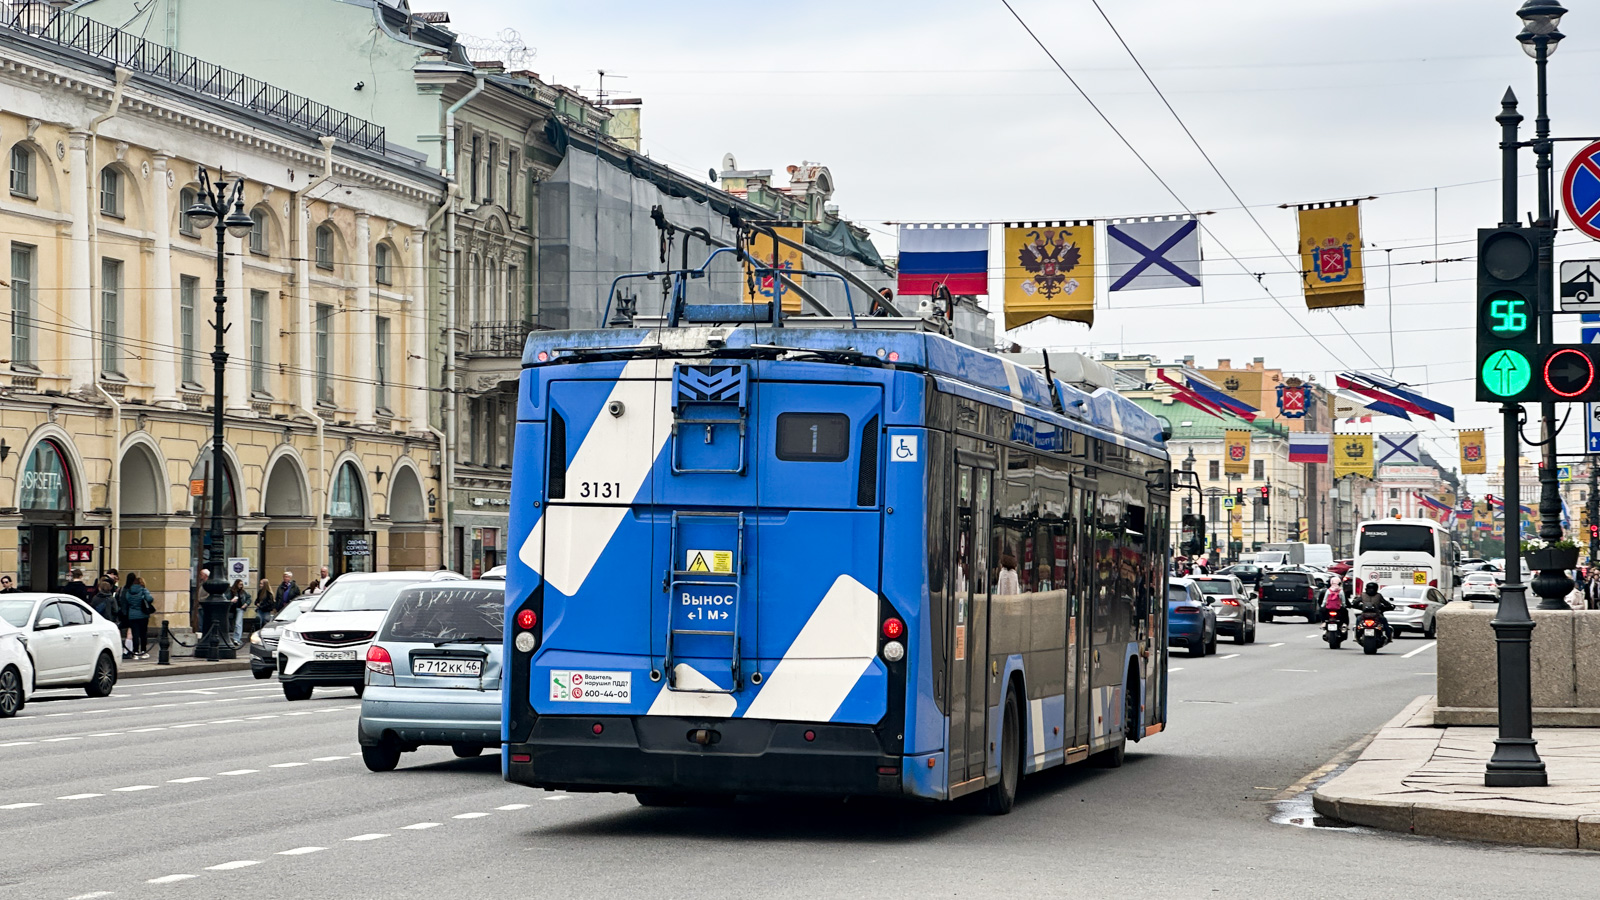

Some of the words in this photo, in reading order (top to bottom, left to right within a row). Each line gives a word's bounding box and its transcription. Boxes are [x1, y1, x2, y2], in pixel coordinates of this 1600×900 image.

[1490, 300, 1526, 331] 56
[809, 424, 818, 453] 1
[580, 482, 621, 498] 3131
[682, 592, 734, 606] Вынос
[697, 607, 703, 620] 1
[584, 673, 613, 681] Водитель
[612, 680, 629, 688] ПДД?
[584, 689, 629, 699] 600-44-00
